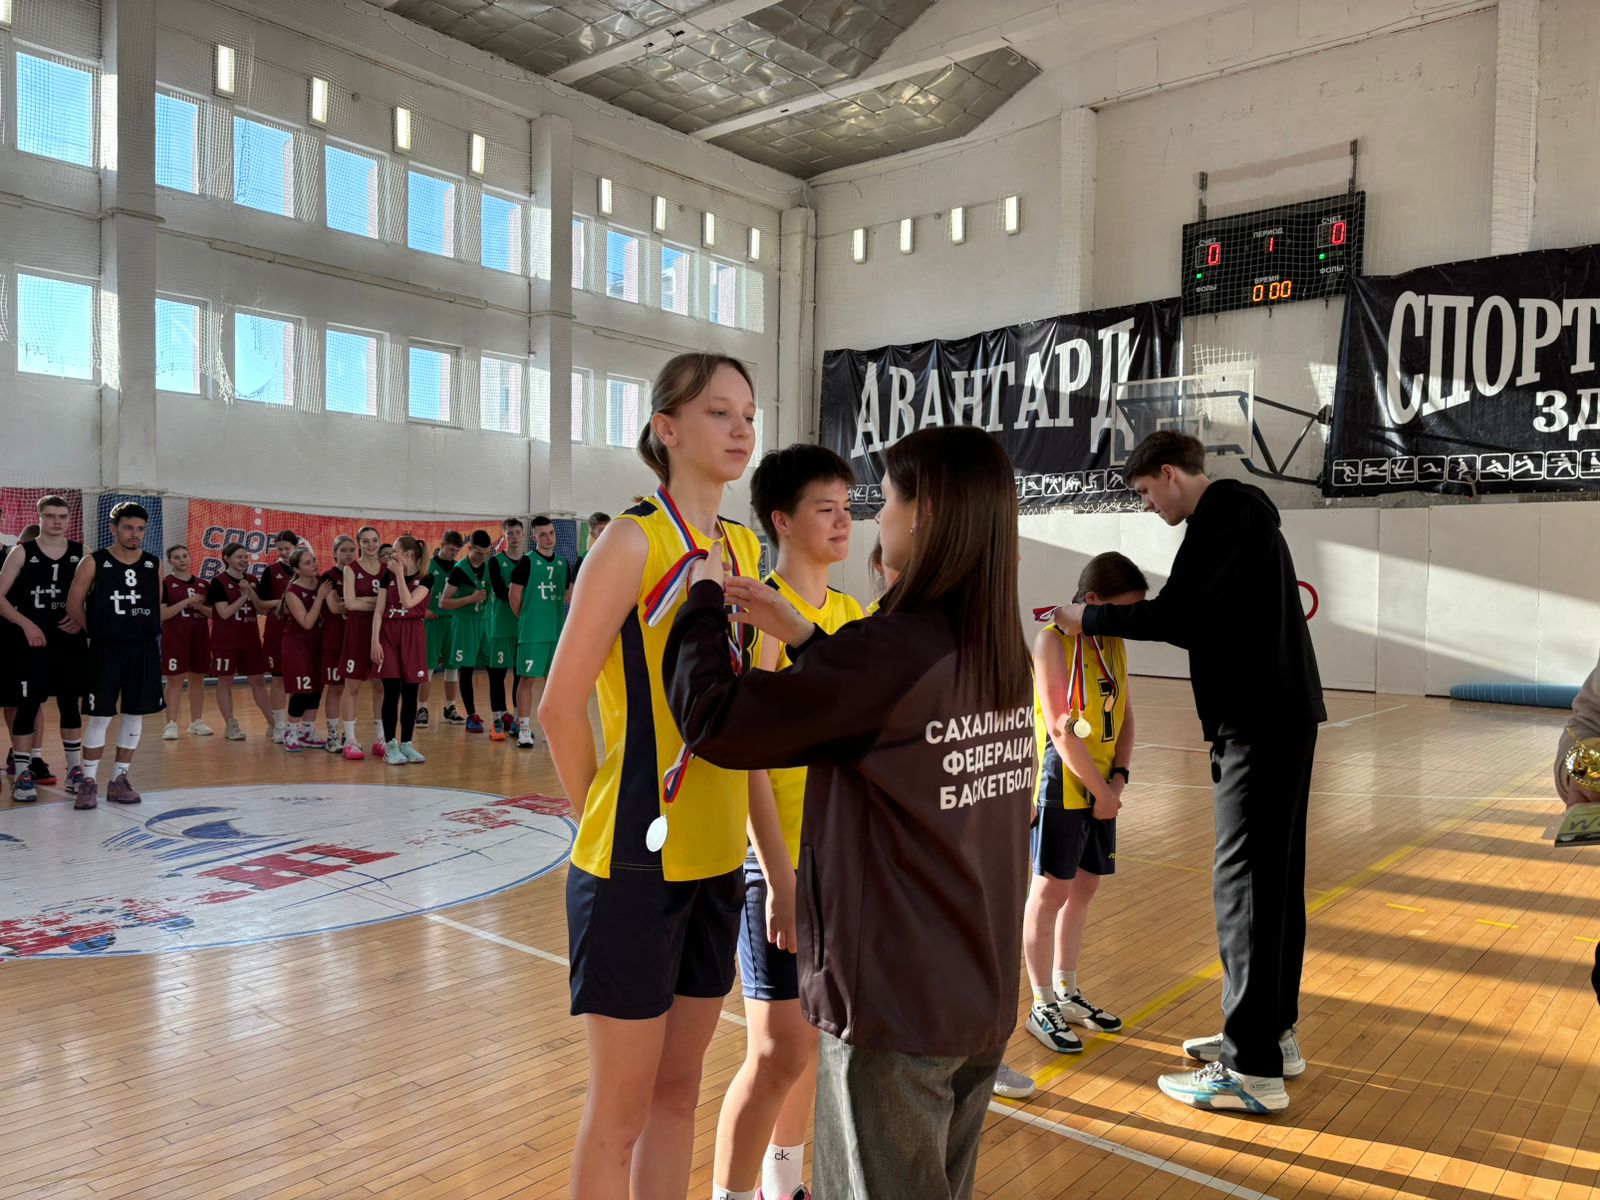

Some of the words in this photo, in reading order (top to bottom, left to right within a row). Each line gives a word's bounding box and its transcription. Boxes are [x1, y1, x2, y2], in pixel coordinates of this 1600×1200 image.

[1253, 227, 1284, 238] ПЕРИОД
[1331, 222, 1345, 245] 0
[1269, 237, 1274, 252] 1
[1208, 243, 1221, 266] 0
[1319, 265, 1344, 274] ФОЛЫ
[1254, 275, 1280, 285] ВРЕМЯ
[1196, 285, 1217, 293] ФОЛЫ
[850, 317, 1135, 460] АВАНГАРД
[202, 526, 279, 556] СПОР
[51, 563, 59, 581] 1
[125, 569, 137, 587] 8
[546, 566, 554, 579] 7
[51, 602, 66, 610] gro
[455, 650, 463, 662] 5
[497, 651, 504, 664] 3
[168, 658, 178, 671] 6
[216, 658, 230, 671] 11
[346, 659, 355, 673] 9
[525, 660, 534, 673] 7
[21, 681, 28, 698] 1
[296, 676, 312, 690] 12
[925, 706, 1034, 745] САХАЛИНСК
[942, 736, 1033, 776] ФЕДЕРАЦИ
[939, 767, 1032, 810] БАСКЕТБОЛ
[774, 1148, 790, 1161] ck
